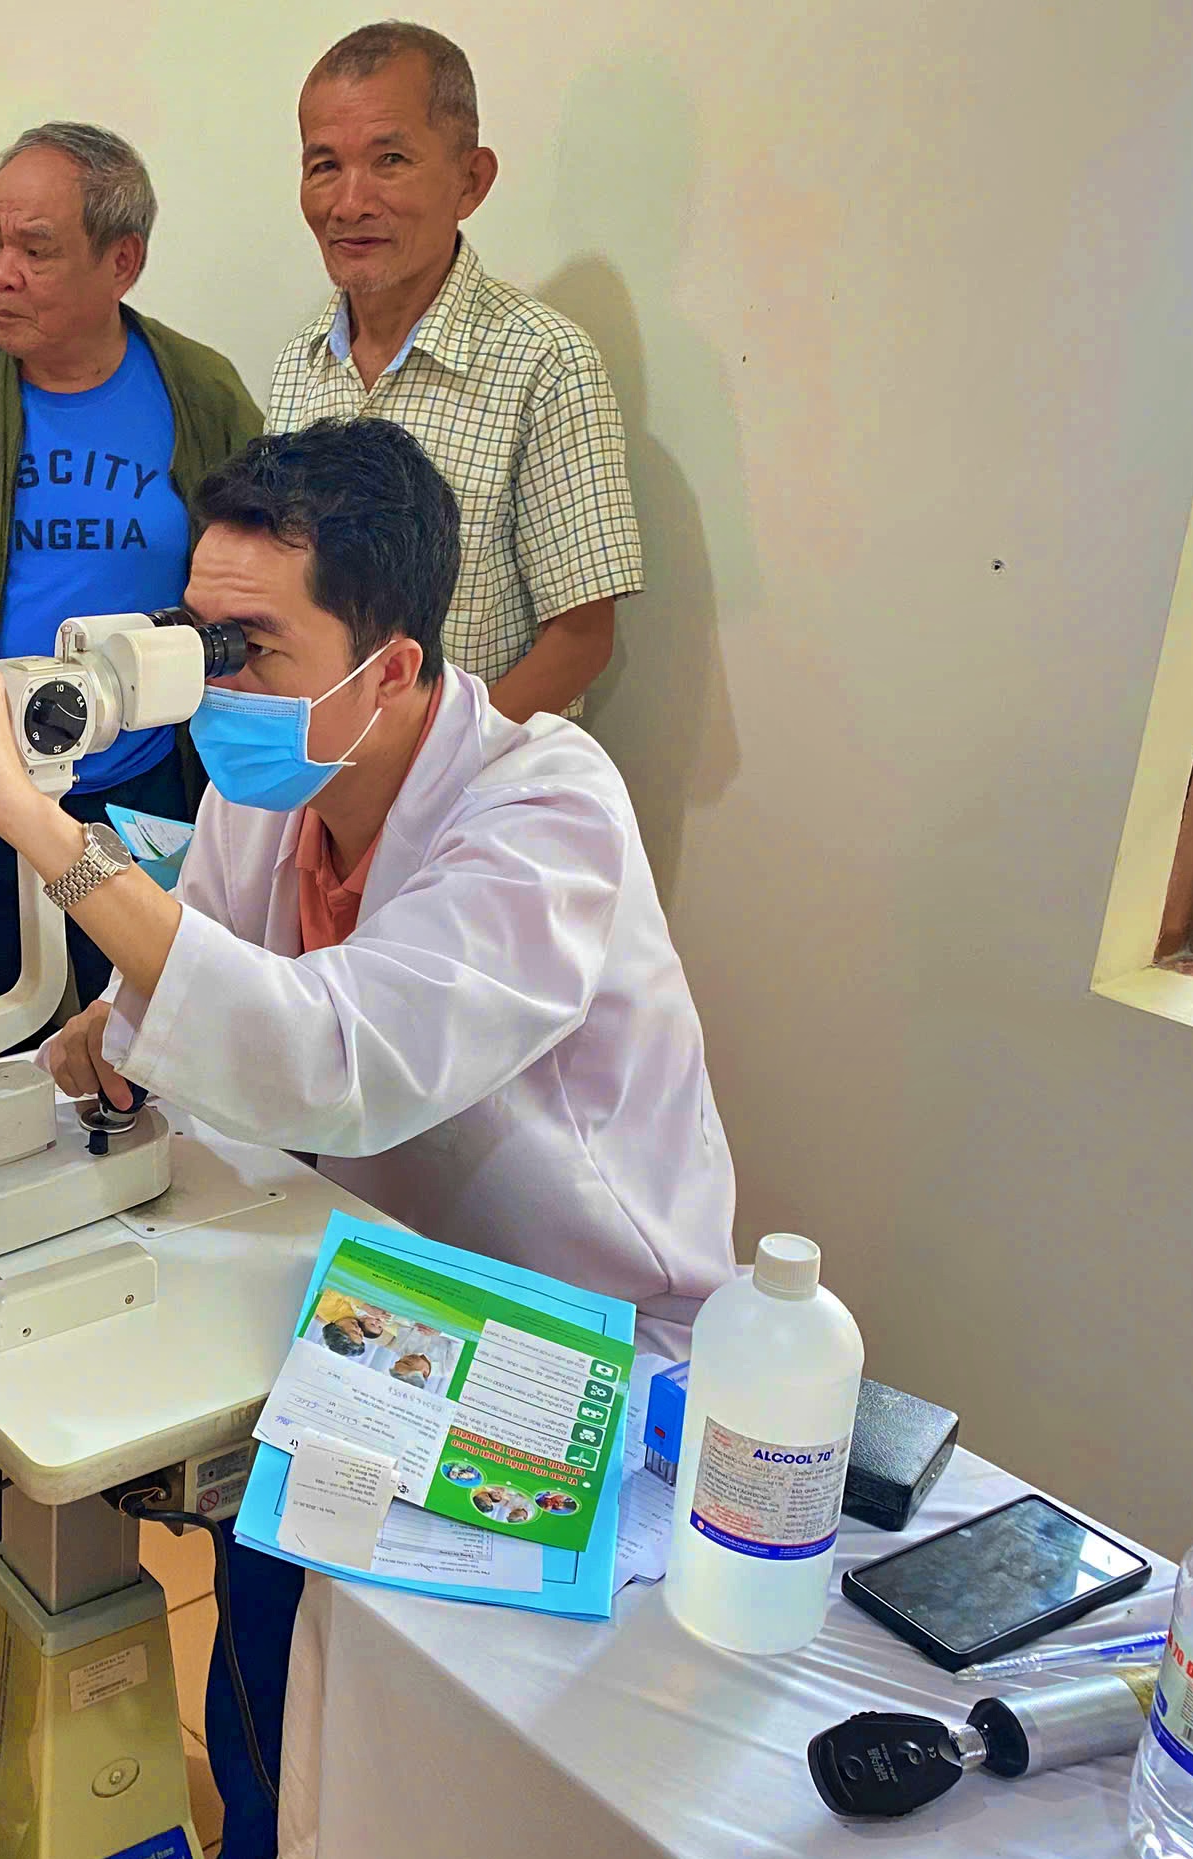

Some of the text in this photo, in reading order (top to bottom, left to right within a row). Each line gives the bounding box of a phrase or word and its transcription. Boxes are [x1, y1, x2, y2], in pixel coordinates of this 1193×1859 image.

[56, 684, 64, 692] 10
[753, 1449, 812, 1465] ALCOOL
[1171, 1640, 1185, 1667] 70
